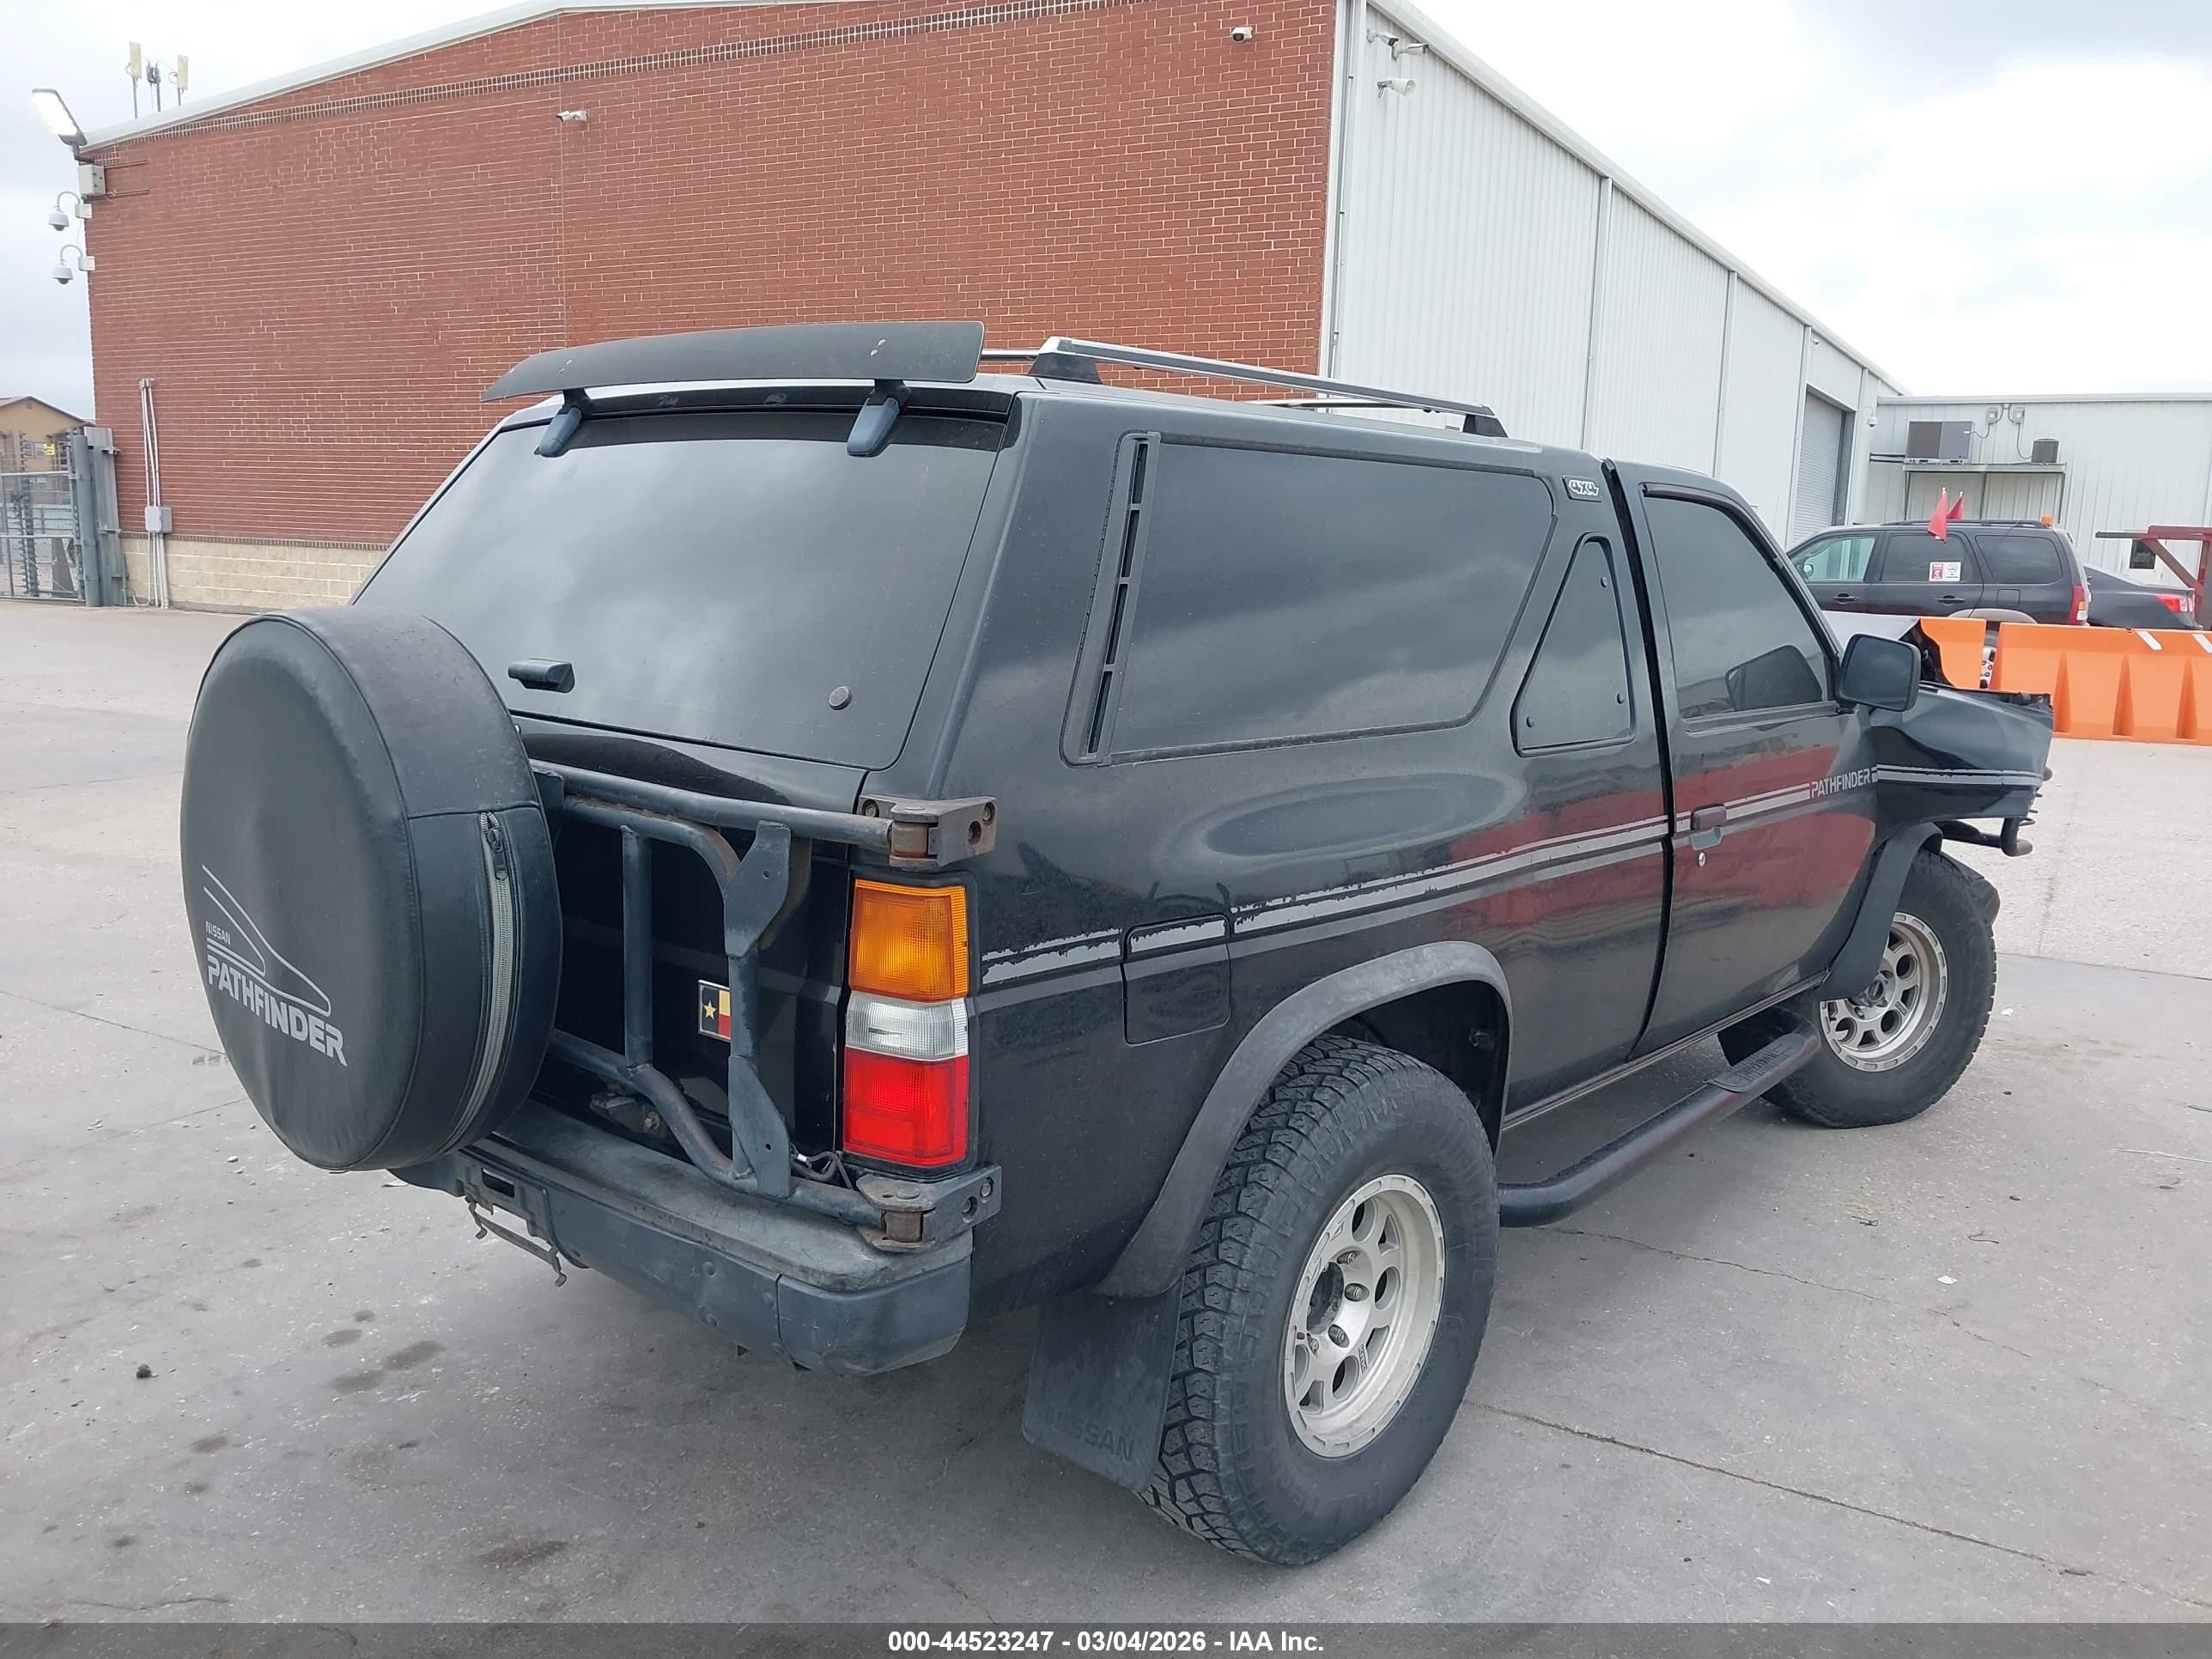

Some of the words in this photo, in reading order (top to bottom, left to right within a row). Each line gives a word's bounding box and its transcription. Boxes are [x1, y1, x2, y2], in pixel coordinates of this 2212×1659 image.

[1812, 769, 1870, 799] PATHFINDER
[205, 921, 231, 945] NISSAN
[207, 954, 348, 1066] PATHFINDER
[1045, 1406, 1134, 1462] NSSAN
